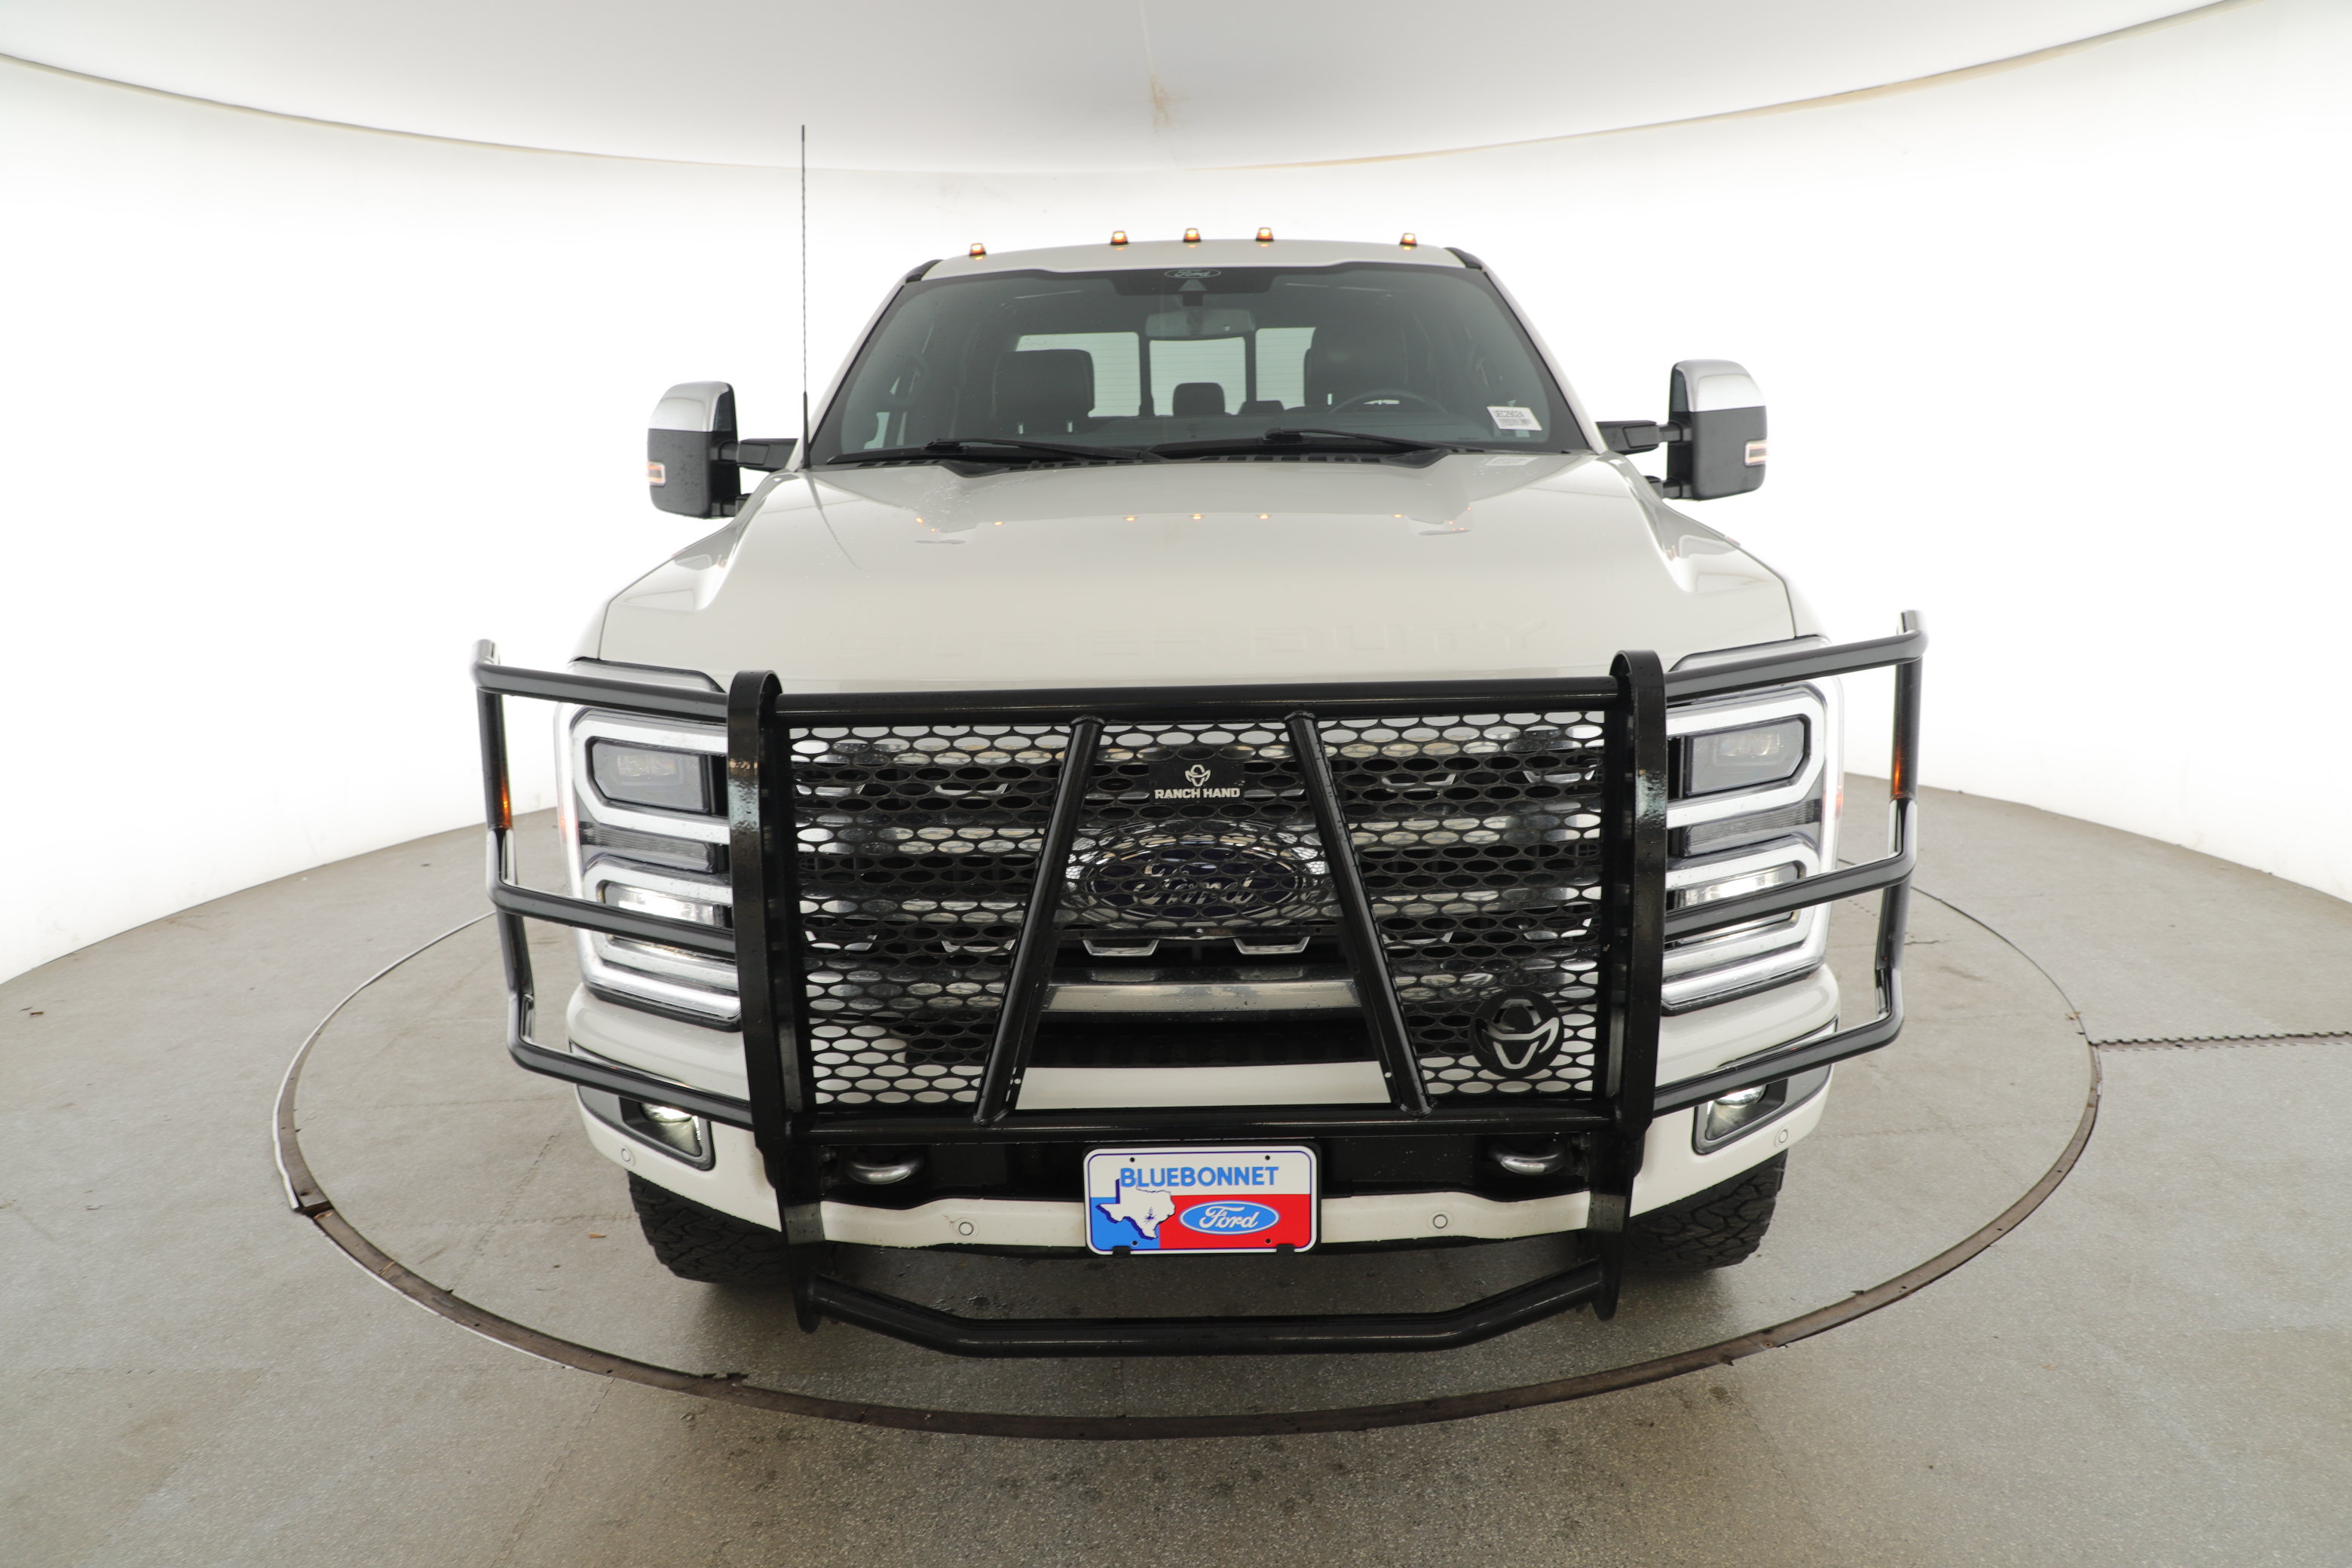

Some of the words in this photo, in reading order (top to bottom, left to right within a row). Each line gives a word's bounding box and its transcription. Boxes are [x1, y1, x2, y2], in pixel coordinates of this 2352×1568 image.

[1174, 269, 1211, 277] Ford
[838, 628, 1223, 663] SUPER
[1248, 619, 1547, 657] DUTY
[1154, 788, 1201, 800] RANCH
[1203, 787, 1241, 798] HAND
[1119, 1165, 1280, 1188] BLUEBONNET
[1198, 1205, 1260, 1229] Ford
